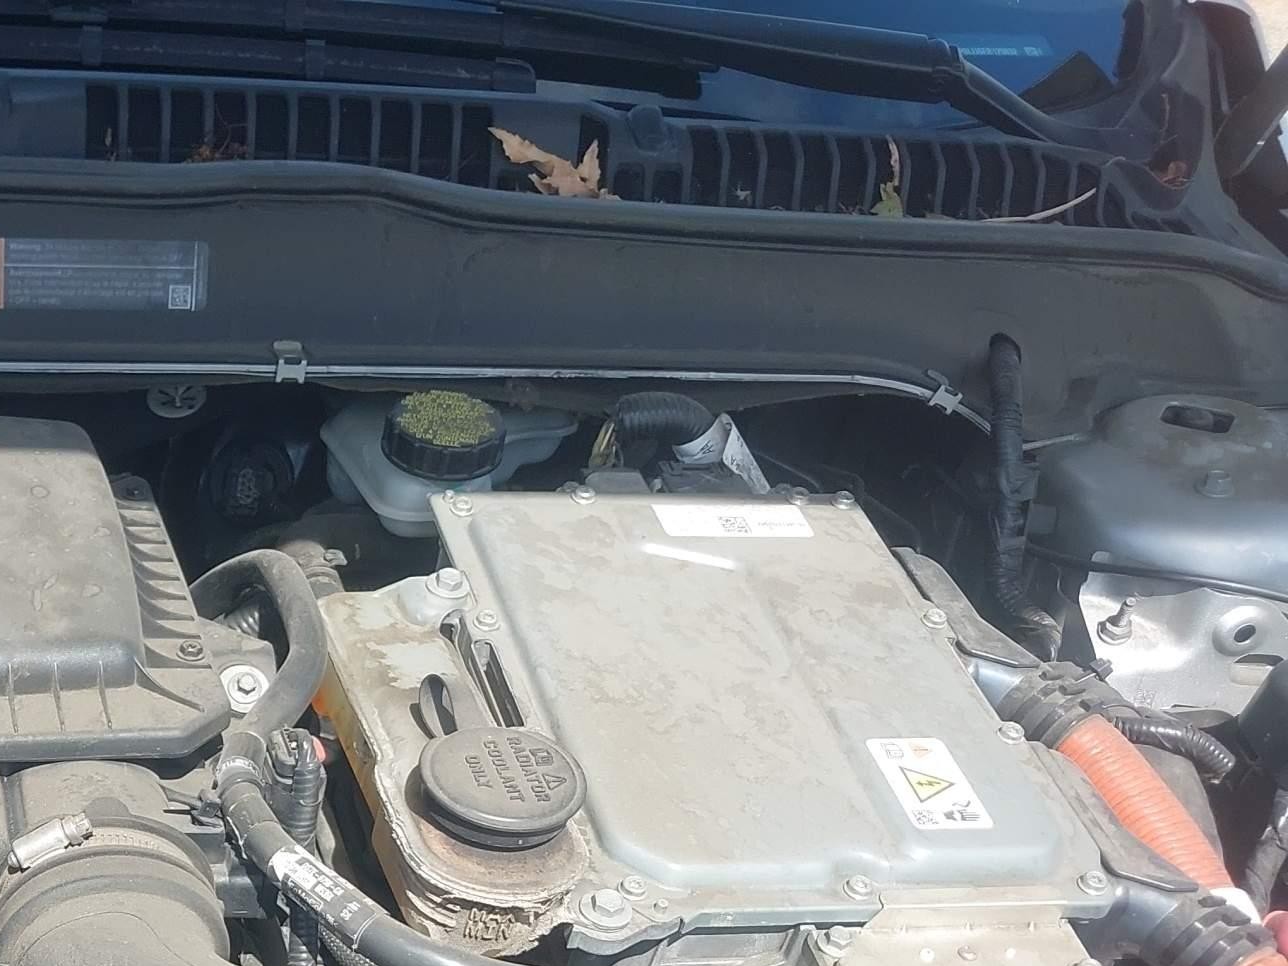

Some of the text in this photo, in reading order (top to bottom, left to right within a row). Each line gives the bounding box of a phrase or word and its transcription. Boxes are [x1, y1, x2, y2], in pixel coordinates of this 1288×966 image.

[464, 754, 494, 790] ONLY
[483, 739, 526, 803] COOLANT
[506, 736, 552, 803] RADIATOR
